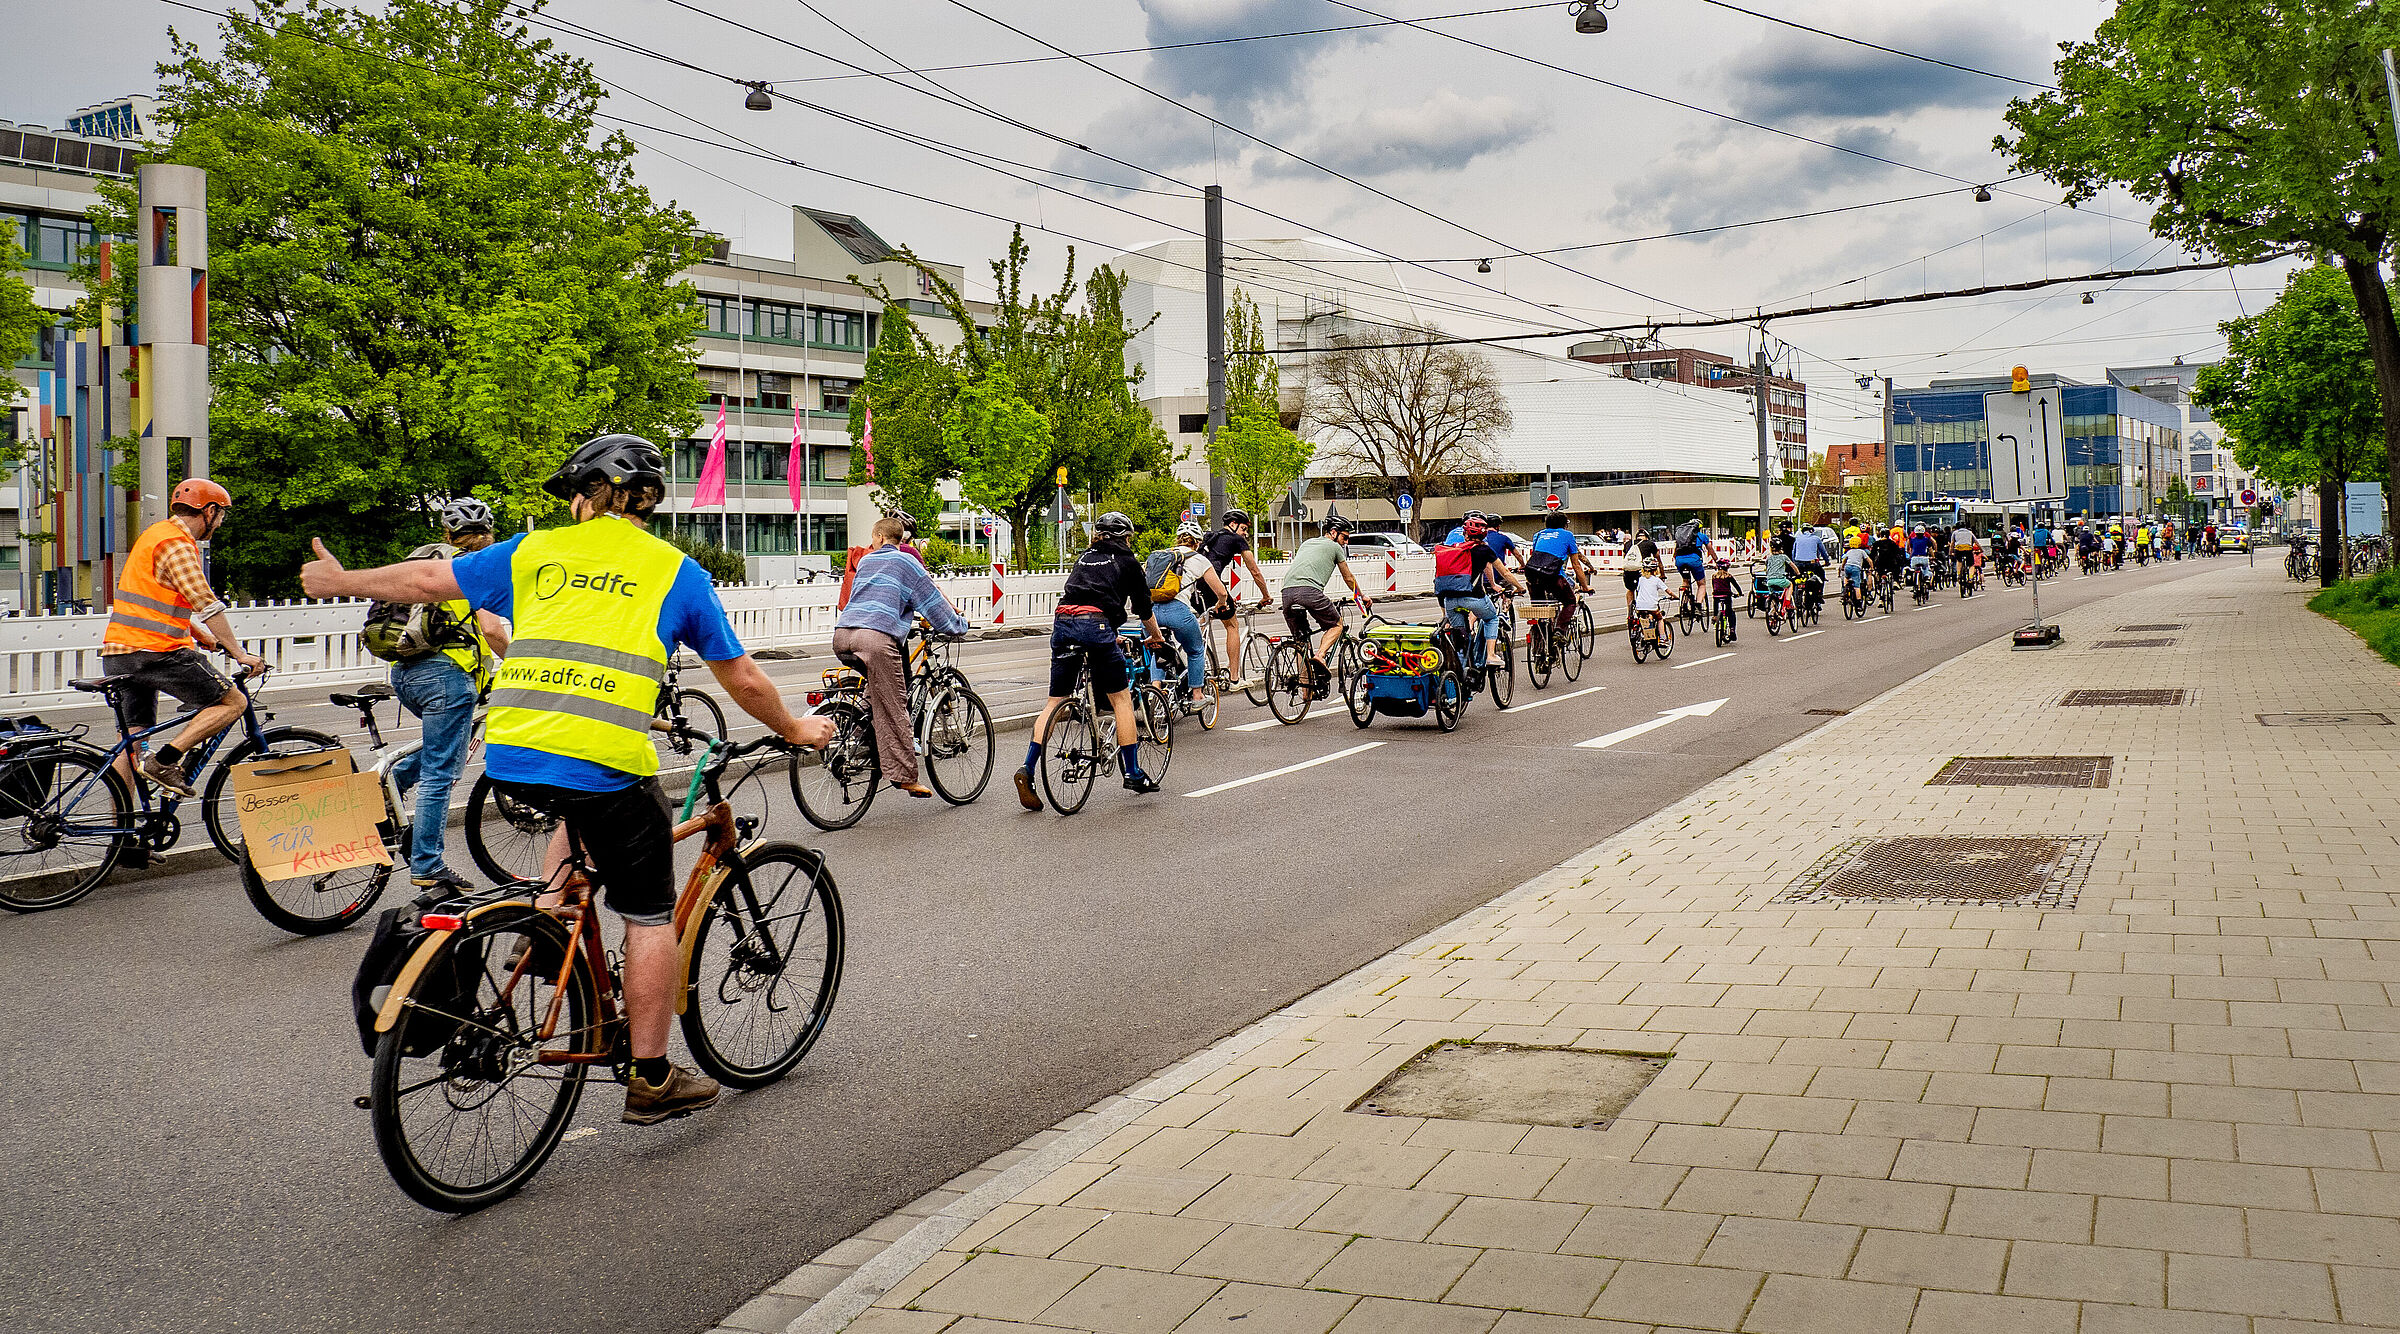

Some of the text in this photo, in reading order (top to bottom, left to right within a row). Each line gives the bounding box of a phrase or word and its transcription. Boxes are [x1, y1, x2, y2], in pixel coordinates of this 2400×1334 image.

[570, 572, 637, 598] adfc
[500, 667, 616, 693] www.adfc.de
[188, 724, 233, 781] VICTOR
[241, 793, 300, 813] Bessere
[267, 825, 314, 854] FÜR
[293, 835, 386, 873] KINDER
